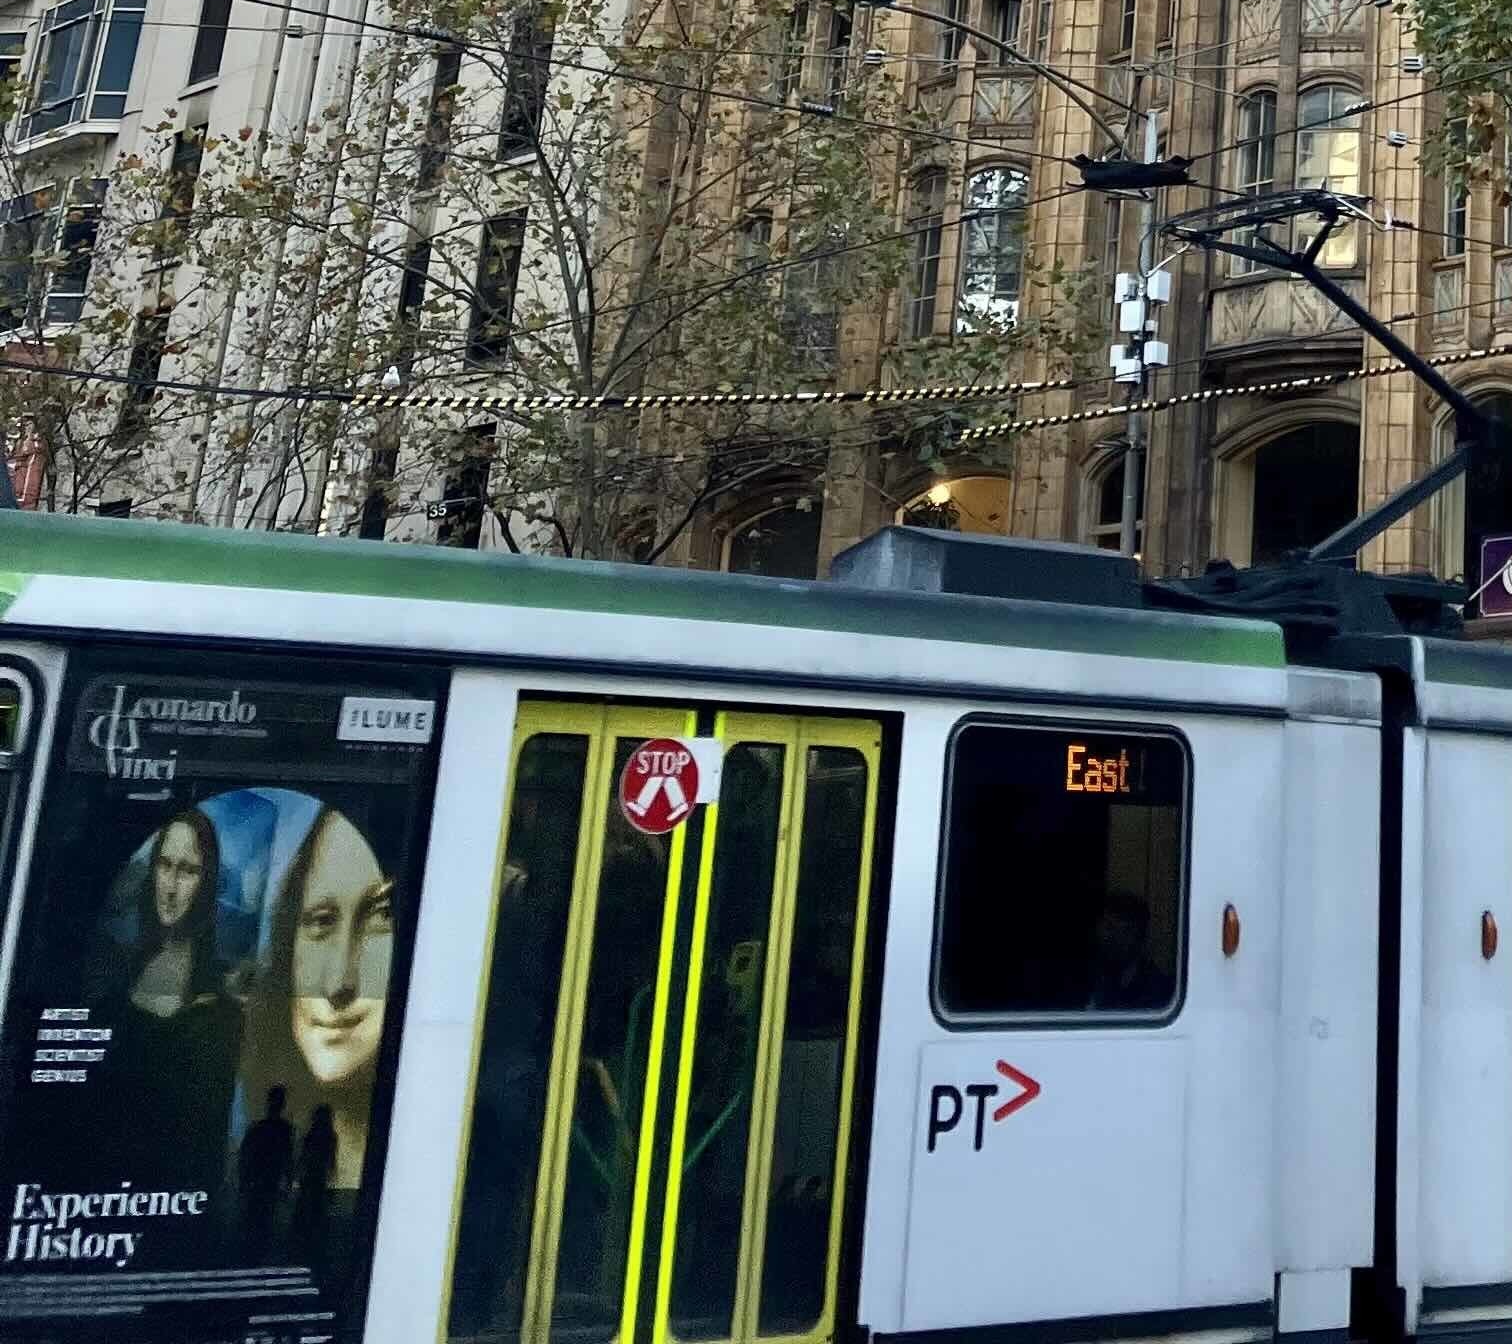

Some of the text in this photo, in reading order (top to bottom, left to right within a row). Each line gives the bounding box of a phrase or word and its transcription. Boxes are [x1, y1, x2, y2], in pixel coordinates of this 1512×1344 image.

[636, 750, 691, 775] STOP
[1066, 745, 1130, 792] East
[12, 1181, 208, 1230] Experience
[5, 1222, 144, 1268] History
